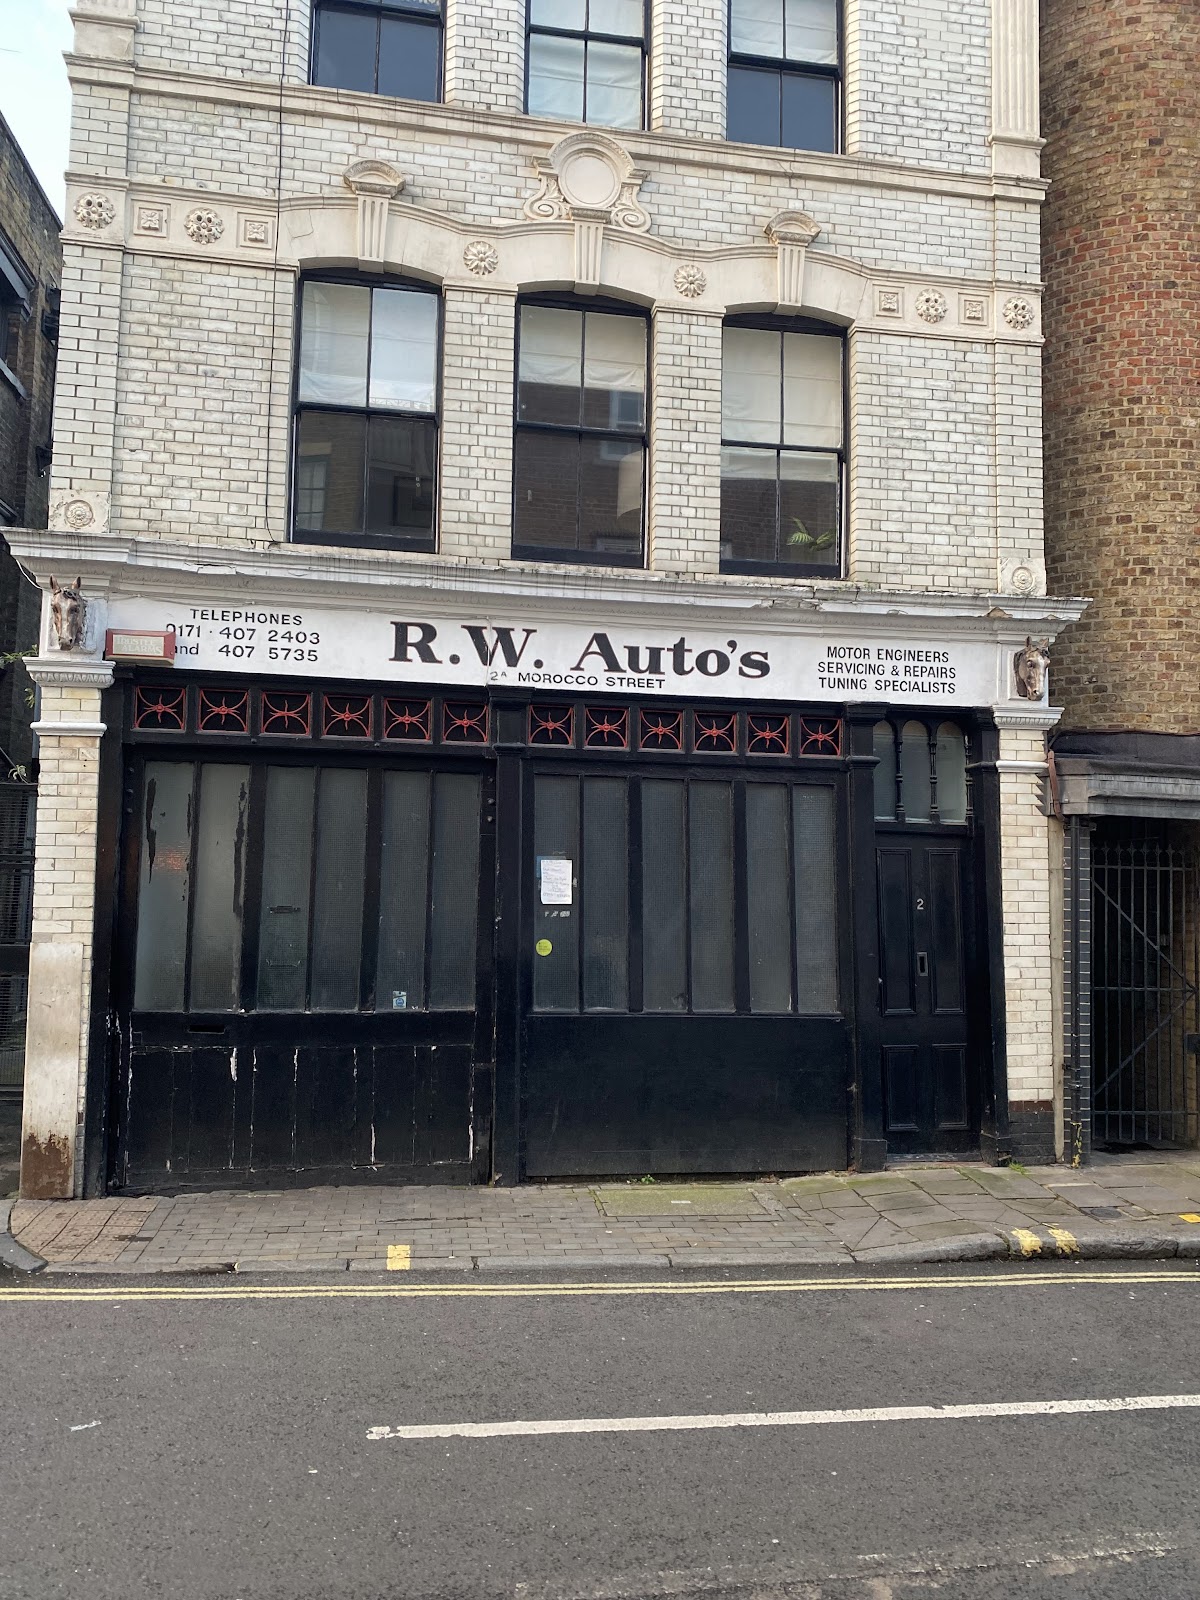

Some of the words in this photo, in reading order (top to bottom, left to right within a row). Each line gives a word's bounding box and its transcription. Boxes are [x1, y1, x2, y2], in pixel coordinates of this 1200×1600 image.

[190, 608, 303, 626] TELEPHONES
[219, 626, 257, 642] 407
[268, 629, 320, 645] 2403
[121, 644, 163, 655] ALARMS
[174, 642, 199, 655] nd
[218, 644, 255, 659] 407
[268, 647, 319, 663] 5735
[570, 632, 771, 679] Auto's
[827, 646, 871, 660] MOTOR
[877, 648, 949, 663] ENGINEERS
[817, 661, 885, 676] SERVICING
[890, 665, 900, 677] &
[904, 665, 956, 679] REPAIRS
[518, 672, 598, 686] MOROCCO
[605, 677, 666, 689] STREET
[818, 677, 867, 690] TUNING
[874, 679, 956, 694] SPECIALISTS
[916, 898, 924, 910] 2
